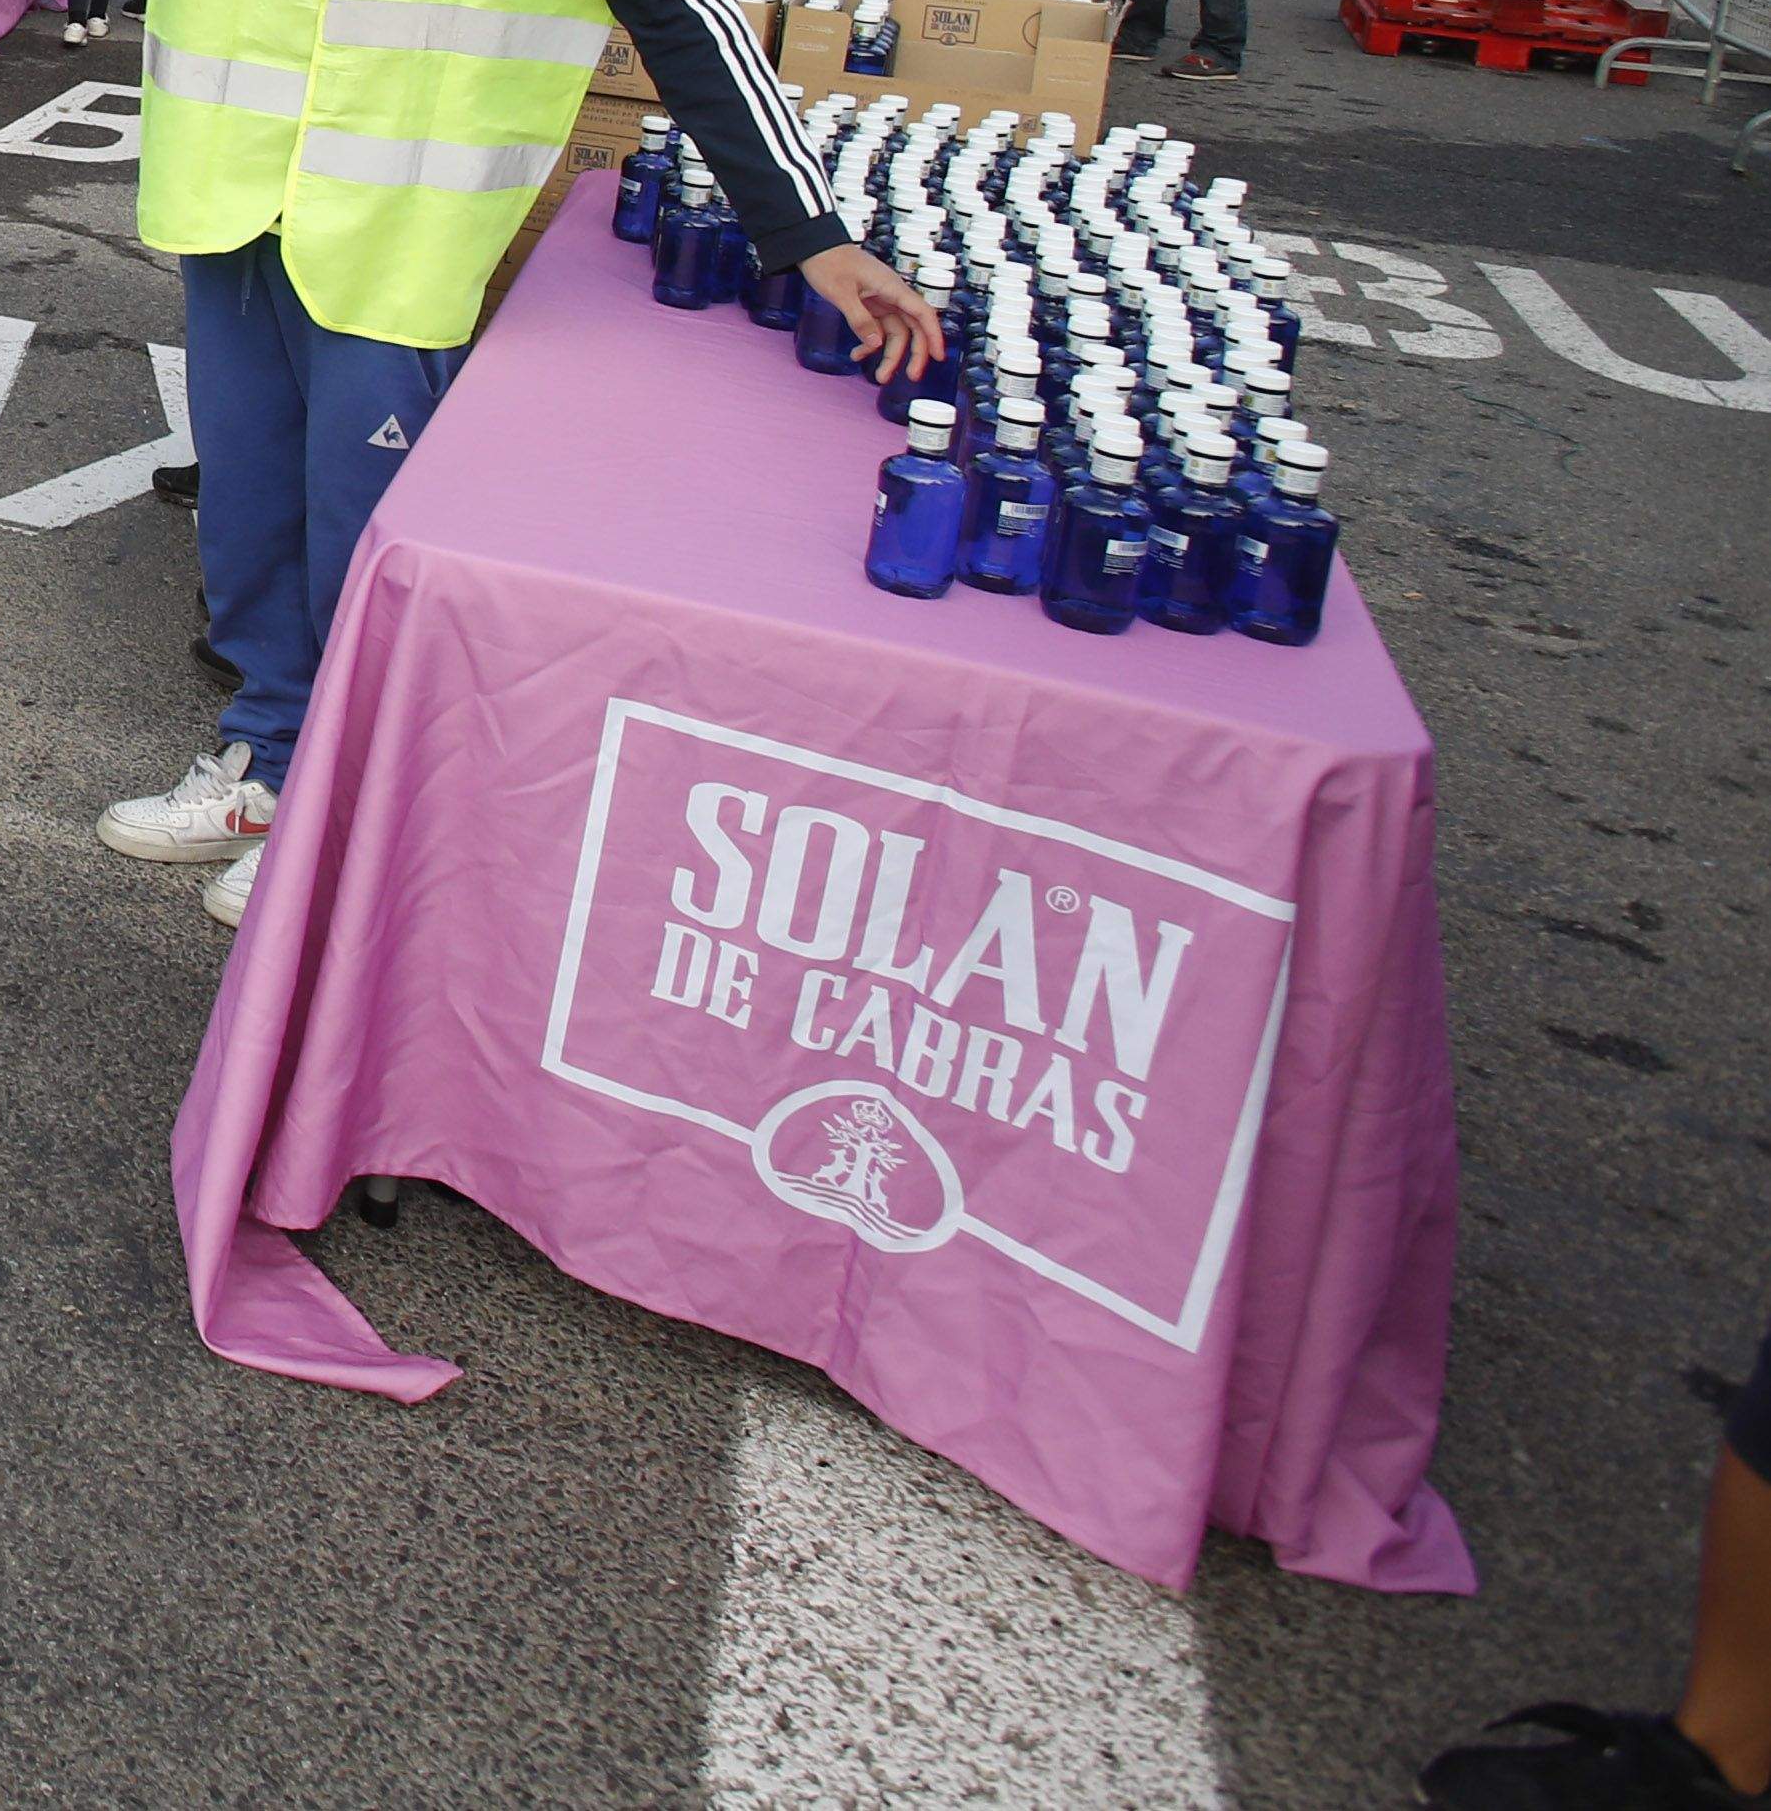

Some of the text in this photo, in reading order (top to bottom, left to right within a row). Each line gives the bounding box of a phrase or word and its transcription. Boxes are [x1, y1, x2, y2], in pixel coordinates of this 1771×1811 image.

[931, 10, 972, 26] SOLAN
[651, 920, 1151, 1175] DE CABRAS
[669, 781, 1194, 1082] SOLAN
